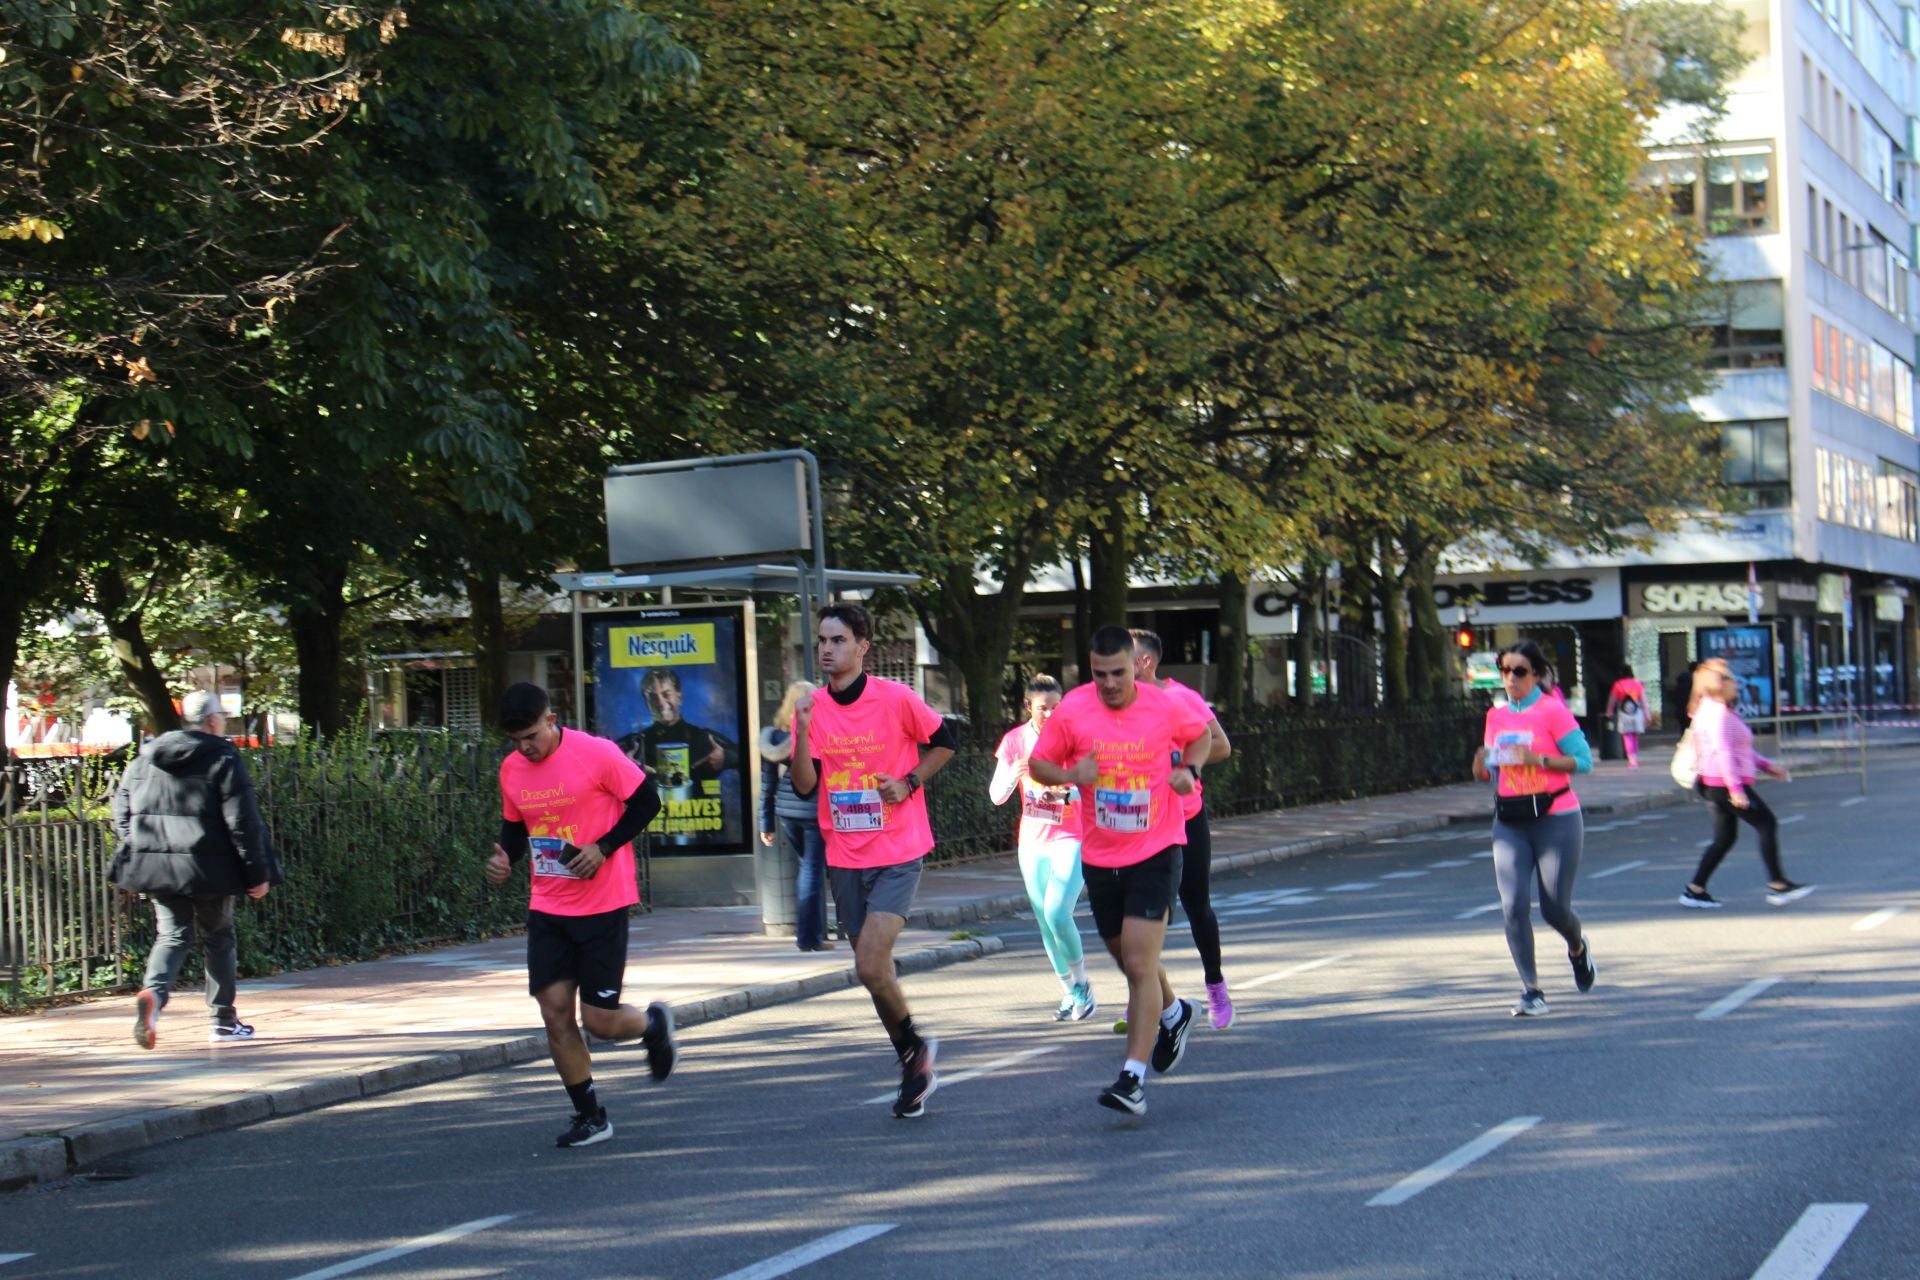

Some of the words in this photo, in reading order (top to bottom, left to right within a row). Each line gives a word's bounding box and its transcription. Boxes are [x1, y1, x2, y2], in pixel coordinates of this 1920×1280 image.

[1644, 583, 1765, 612] SOFASS
[627, 632, 697, 658] Nesquik
[668, 797, 722, 818] RAYES
[846, 803, 871, 814] 4189
[665, 816, 723, 833] JUGANDO
